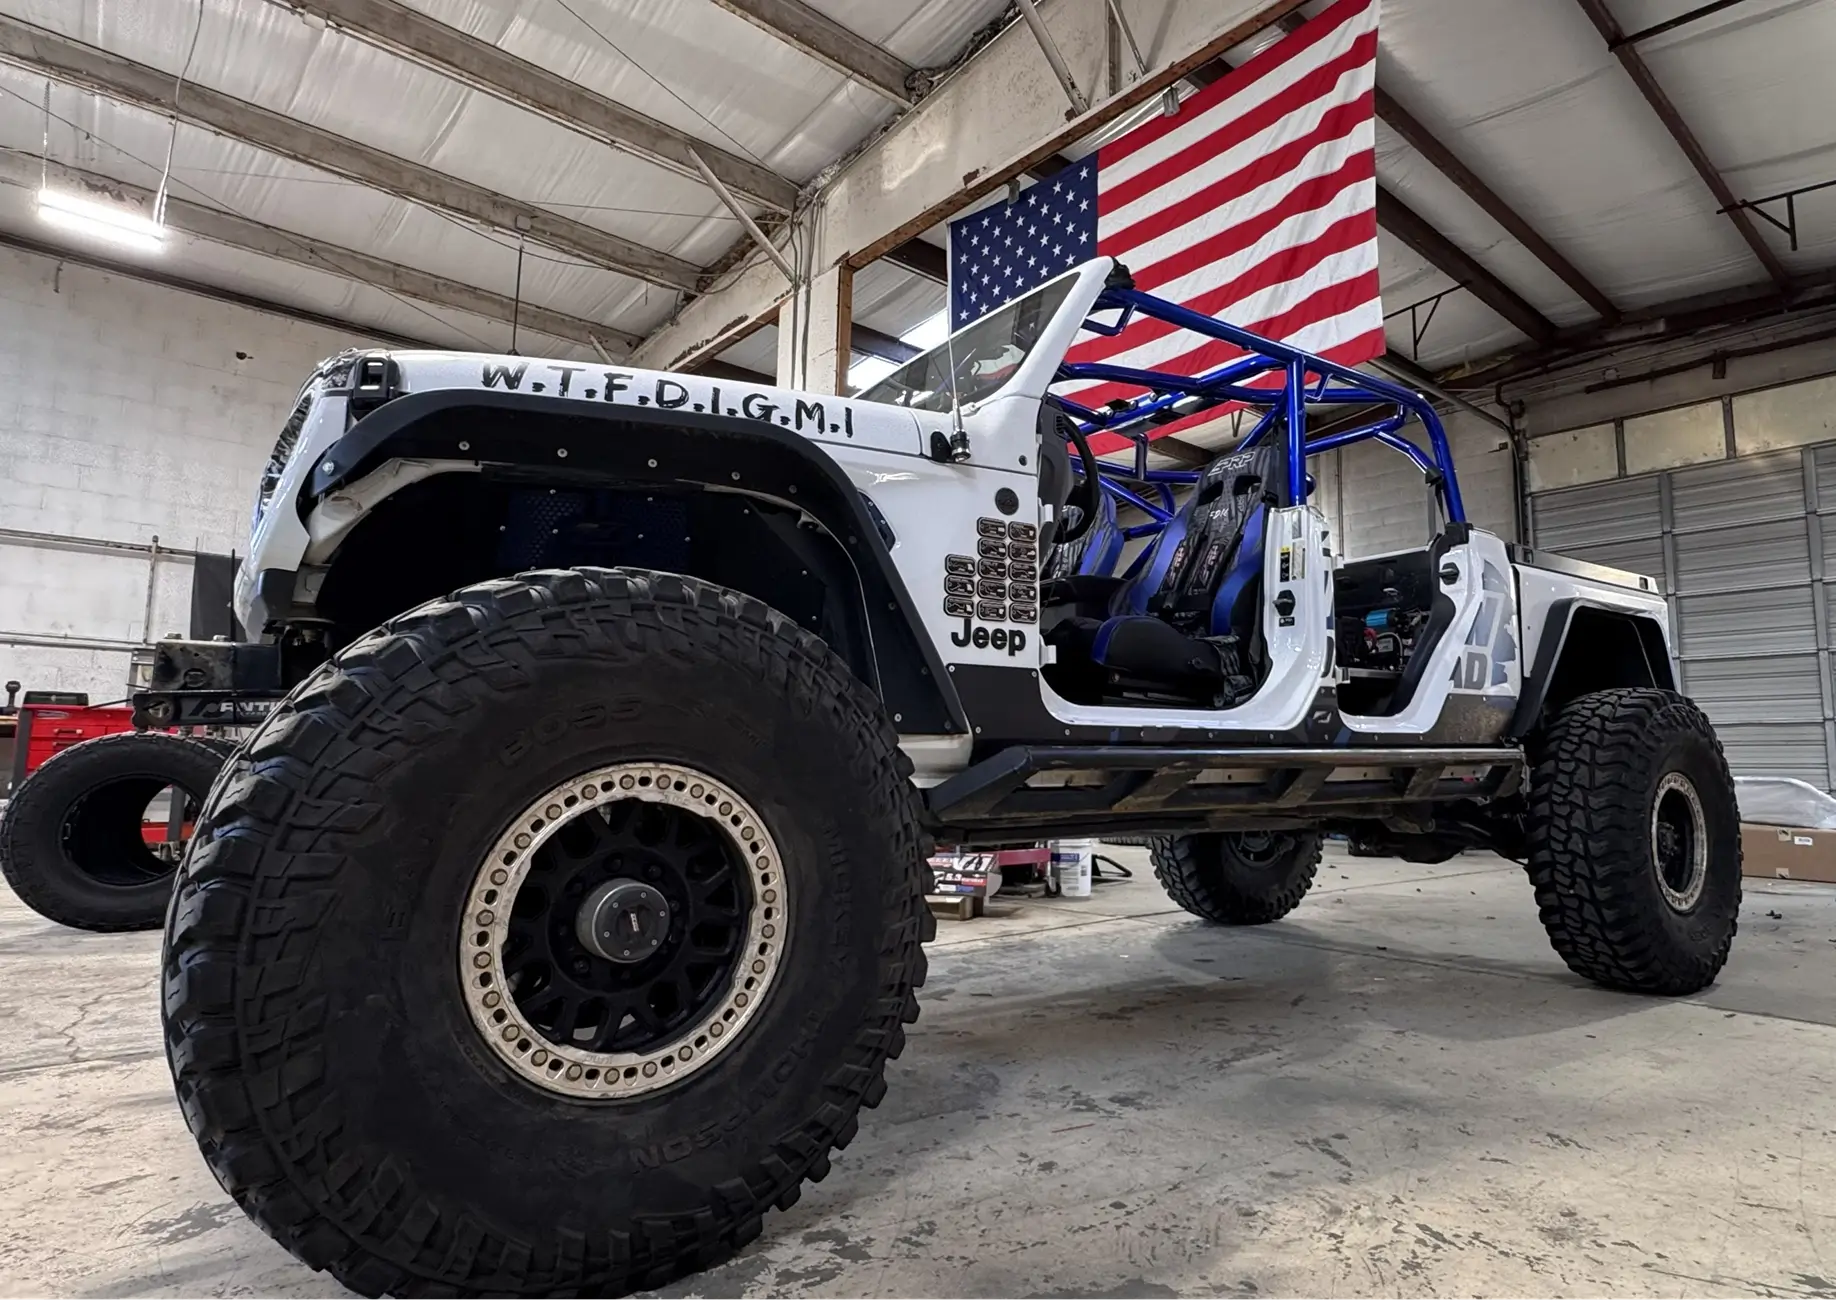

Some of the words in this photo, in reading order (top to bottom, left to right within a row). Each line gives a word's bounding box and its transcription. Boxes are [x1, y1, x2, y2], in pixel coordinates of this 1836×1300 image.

[481, 361, 854, 438] W.T.F.D.I.G.M.I
[1208, 450, 1256, 477] PRP
[950, 619, 1027, 656] Jeep
